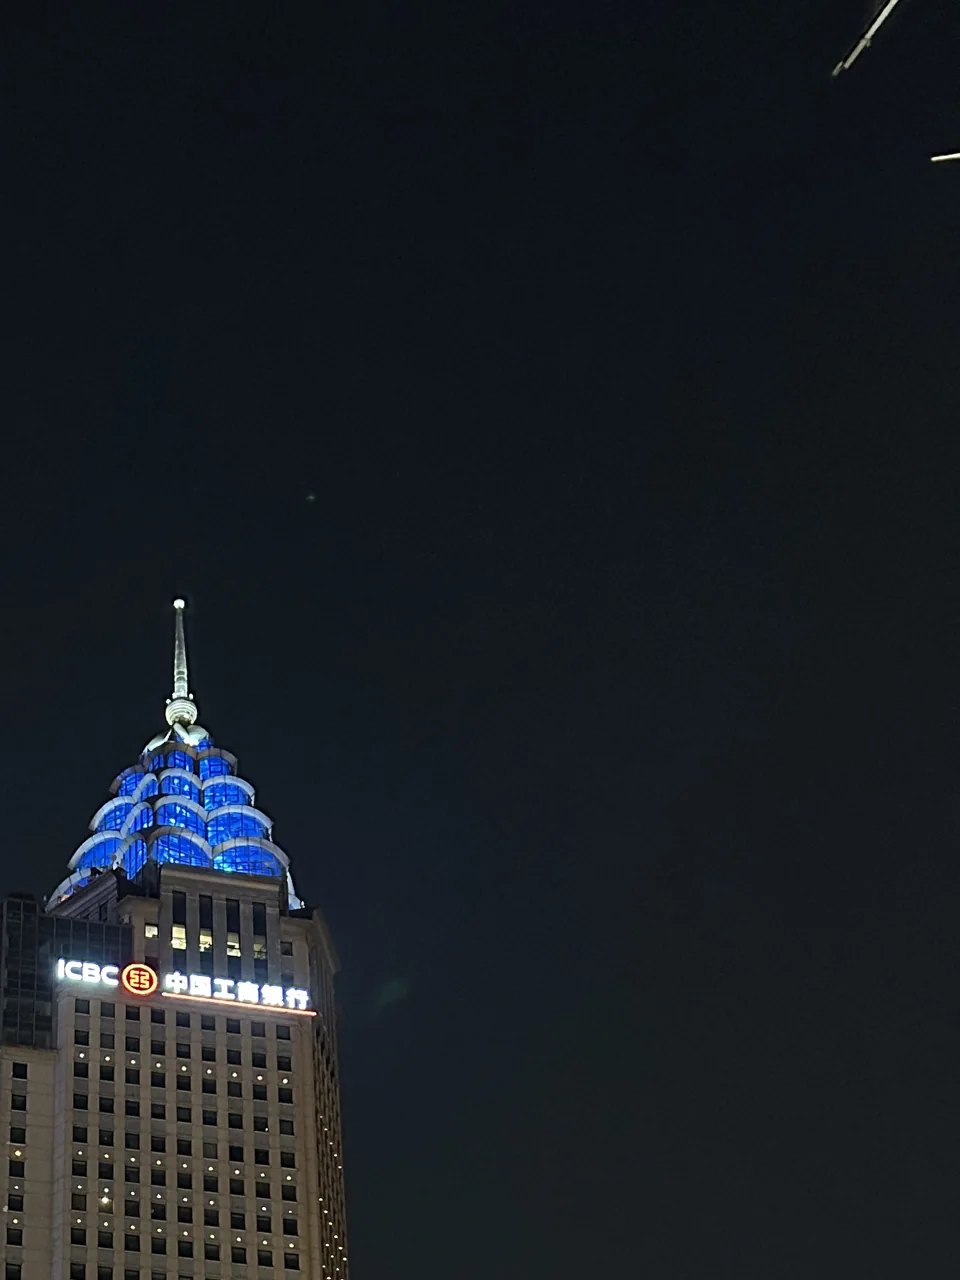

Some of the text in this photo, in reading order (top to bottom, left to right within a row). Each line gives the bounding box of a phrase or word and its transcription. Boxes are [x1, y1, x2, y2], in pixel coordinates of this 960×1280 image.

[57, 958, 119, 986] ICBC
[165, 971, 309, 1010] 中国工商银行
